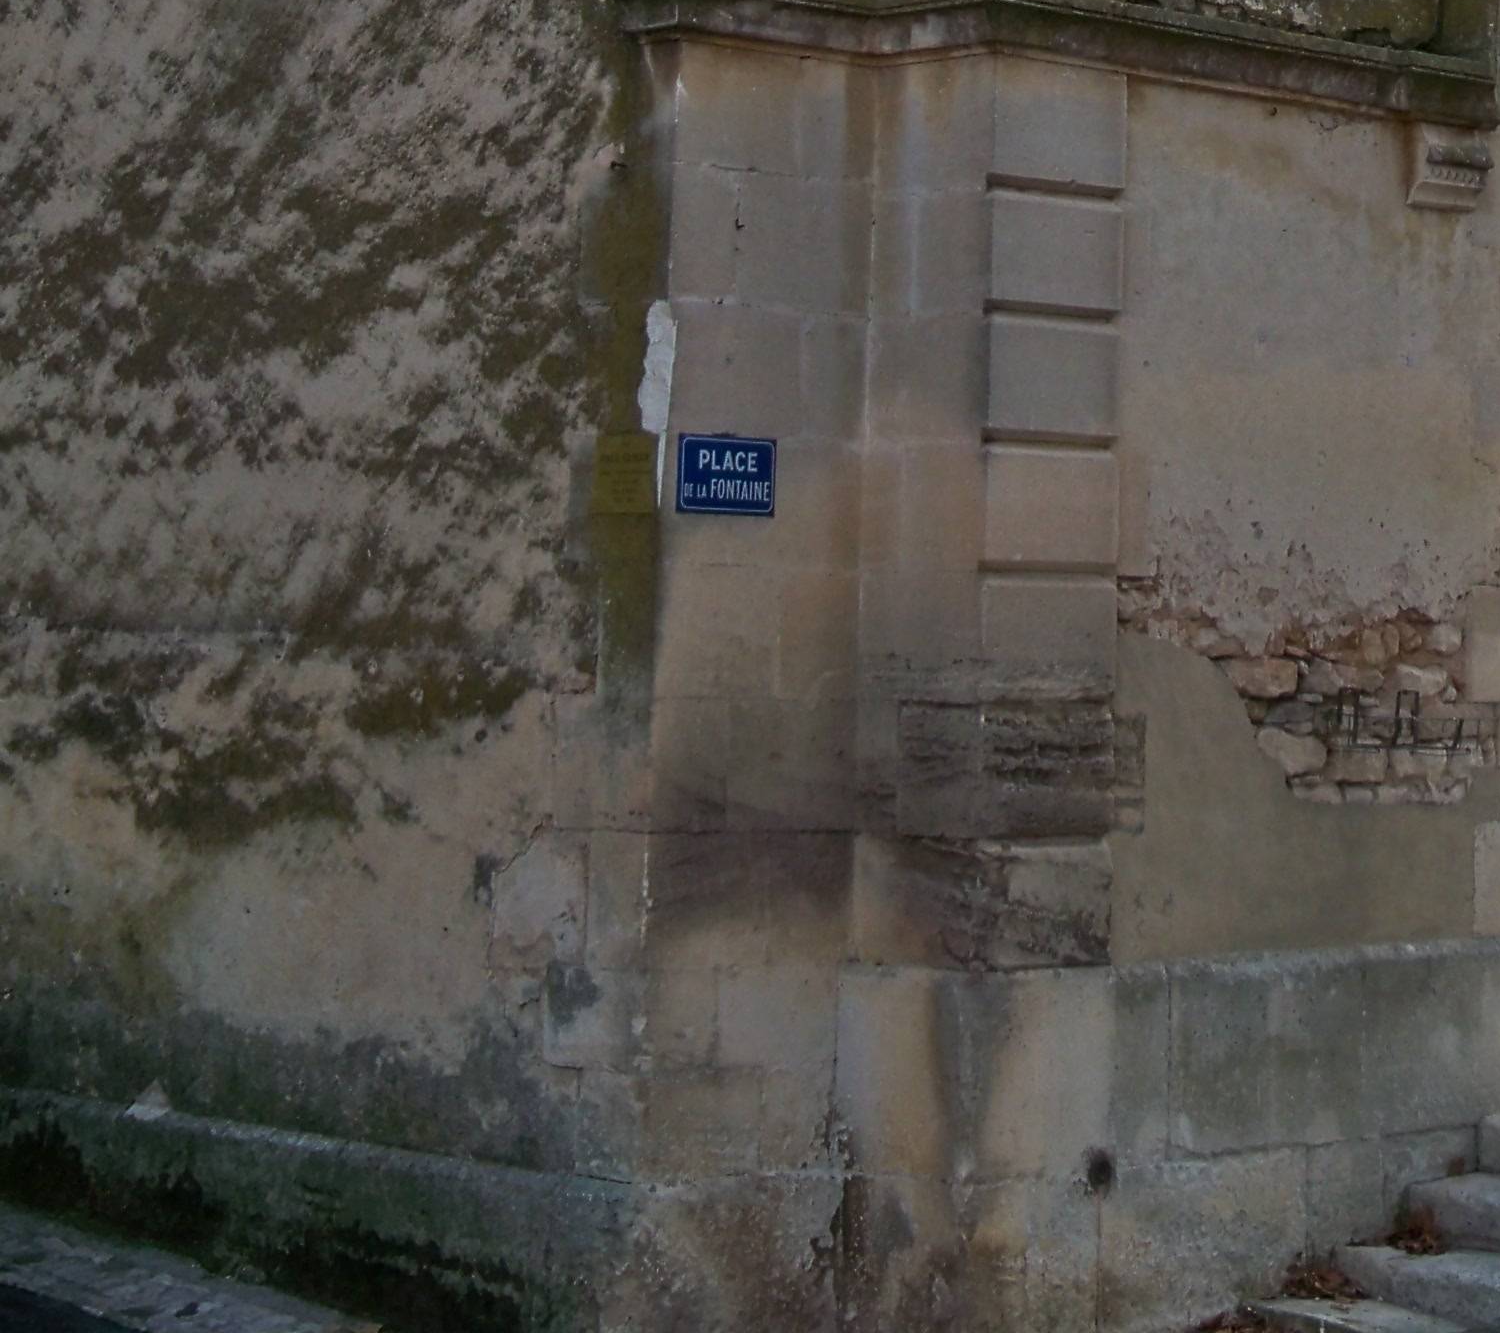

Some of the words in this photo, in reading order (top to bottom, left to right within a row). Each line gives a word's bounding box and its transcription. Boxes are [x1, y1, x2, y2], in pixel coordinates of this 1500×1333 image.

[698, 449, 758, 472] PLACE
[684, 482, 694, 497] DE
[697, 483, 707, 498] LA
[710, 478, 770, 502] FONTAINE
